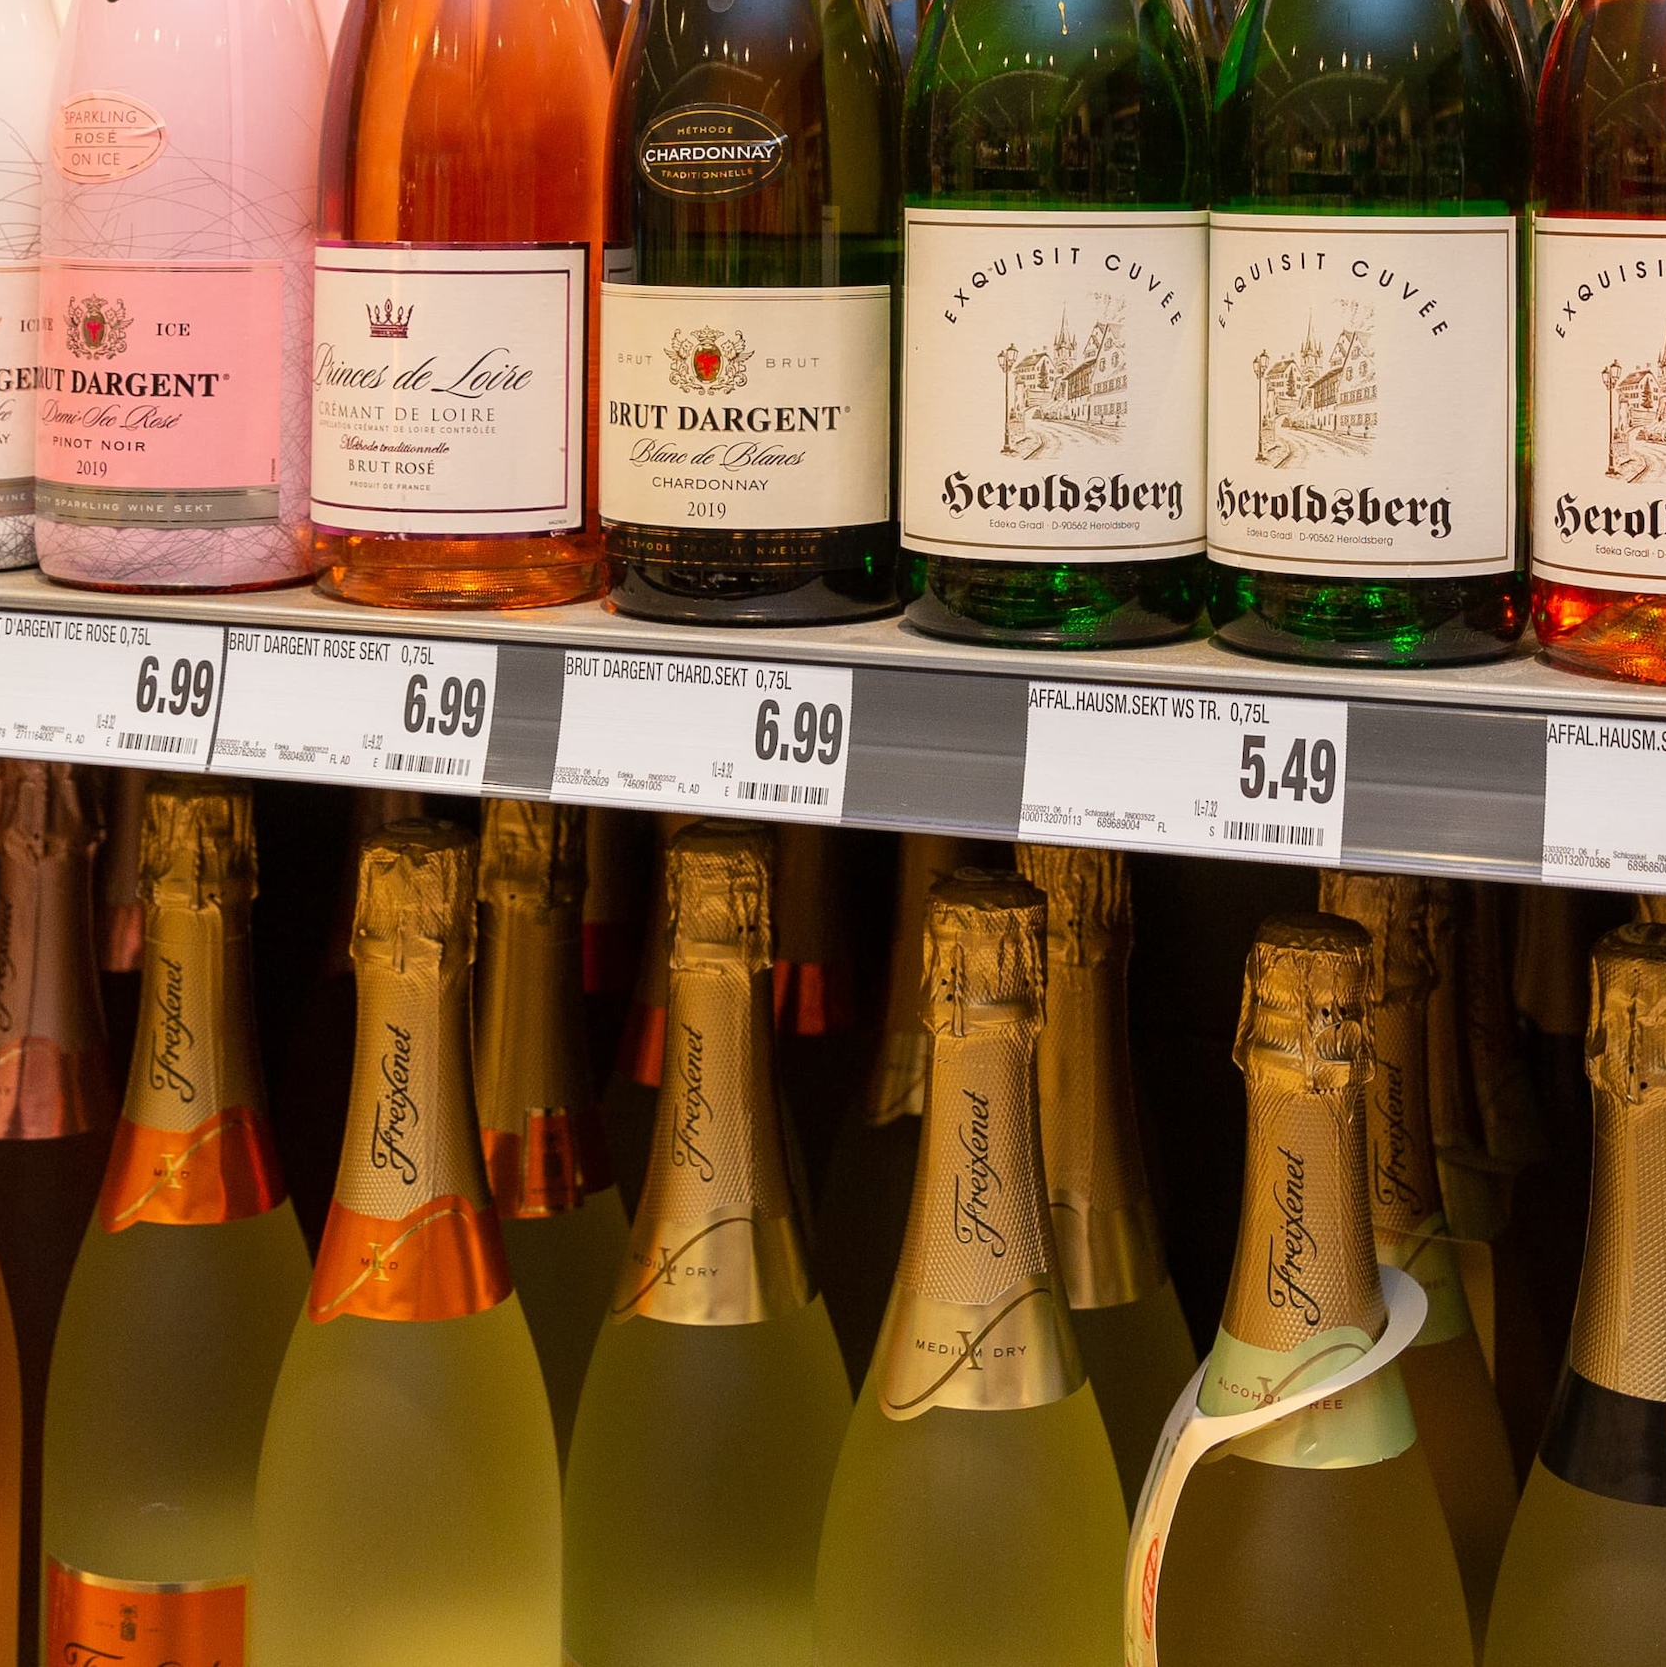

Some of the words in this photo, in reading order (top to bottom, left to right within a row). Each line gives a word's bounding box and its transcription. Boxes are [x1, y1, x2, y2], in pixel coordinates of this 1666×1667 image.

[64, 108, 138, 126] SPARKLING
[677, 124, 733, 136] MÉTHODE
[74, 128, 117, 145] ROSÉ
[645, 143, 775, 162] CHARDONNAY
[661, 166, 755, 180] TRADITIONNELLE
[943, 246, 1082, 326] EXQUISIT
[1104, 253, 1183, 327] CUVÉE
[156, 322, 191, 337] ICE
[313, 342, 389, 392] Princes
[393, 356, 437, 391] de
[431, 347, 534, 399] Loire
[765, 356, 820, 369] BRUT
[71, 367, 220, 398] DARGENT
[120, 403, 181, 431] Rosé
[318, 400, 384, 421] CRÉMANT
[394, 406, 419, 422] DE
[431, 406, 495, 422] LOIRE
[609, 401, 667, 432] BRUT
[678, 405, 842, 433] DARGENT
[52, 436, 92, 451] PINOT
[101, 438, 146, 453] NOIR
[629, 437, 689, 466] Blanc
[695, 448, 717, 466] de
[720, 438, 806, 470] Blancs
[348, 458, 391, 475] BRUT
[395, 458, 435, 476] ROSÉ
[652, 475, 769, 492] CHARDONNAY
[940, 471, 1185, 520] Heroldsberg
[55, 498, 120, 511] SPARKLING
[127, 502, 165, 512] WINE
[174, 503, 214, 513] SEKT
[686, 501, 727, 521] 2019
[989, 518, 1017, 530] Edeka
[1019, 518, 1046, 530] Gradl
[1051, 520, 1088, 531] D-90562
[1090, 519, 1141, 532] Heroldsberg
[3, 616, 62, 640] D'ARGENT
[64, 621, 83, 641] ICE
[85, 622, 117, 643] ROSE
[119, 624, 151, 648] 0,75L
[134, 654, 214, 718] 6.99
[566, 656, 600, 678] BRUT
[603, 659, 664, 683] DARGENT
[667, 663, 748, 688] CHARD.SEKT
[755, 669, 793, 694] 0,75L
[403, 673, 487, 738] 6.99
[1029, 687, 1168, 718] AFFAL.HAUSM.SEKT
[1171, 696, 1195, 720] WS
[1198, 699, 1221, 722] TR.
[1229, 701, 1270, 727] 0,75L
[754, 698, 844, 766] 6.99
[1239, 734, 1337, 805] 5.49
[1193, 798, 1219, 819] 1L=7.32
[369, 1022, 421, 1185] Freixenet
[952, 1088, 1007, 1260] Freixenet
[1265, 1145, 1321, 1329] Freixenet
[993, 1343, 1029, 1361] DRY
